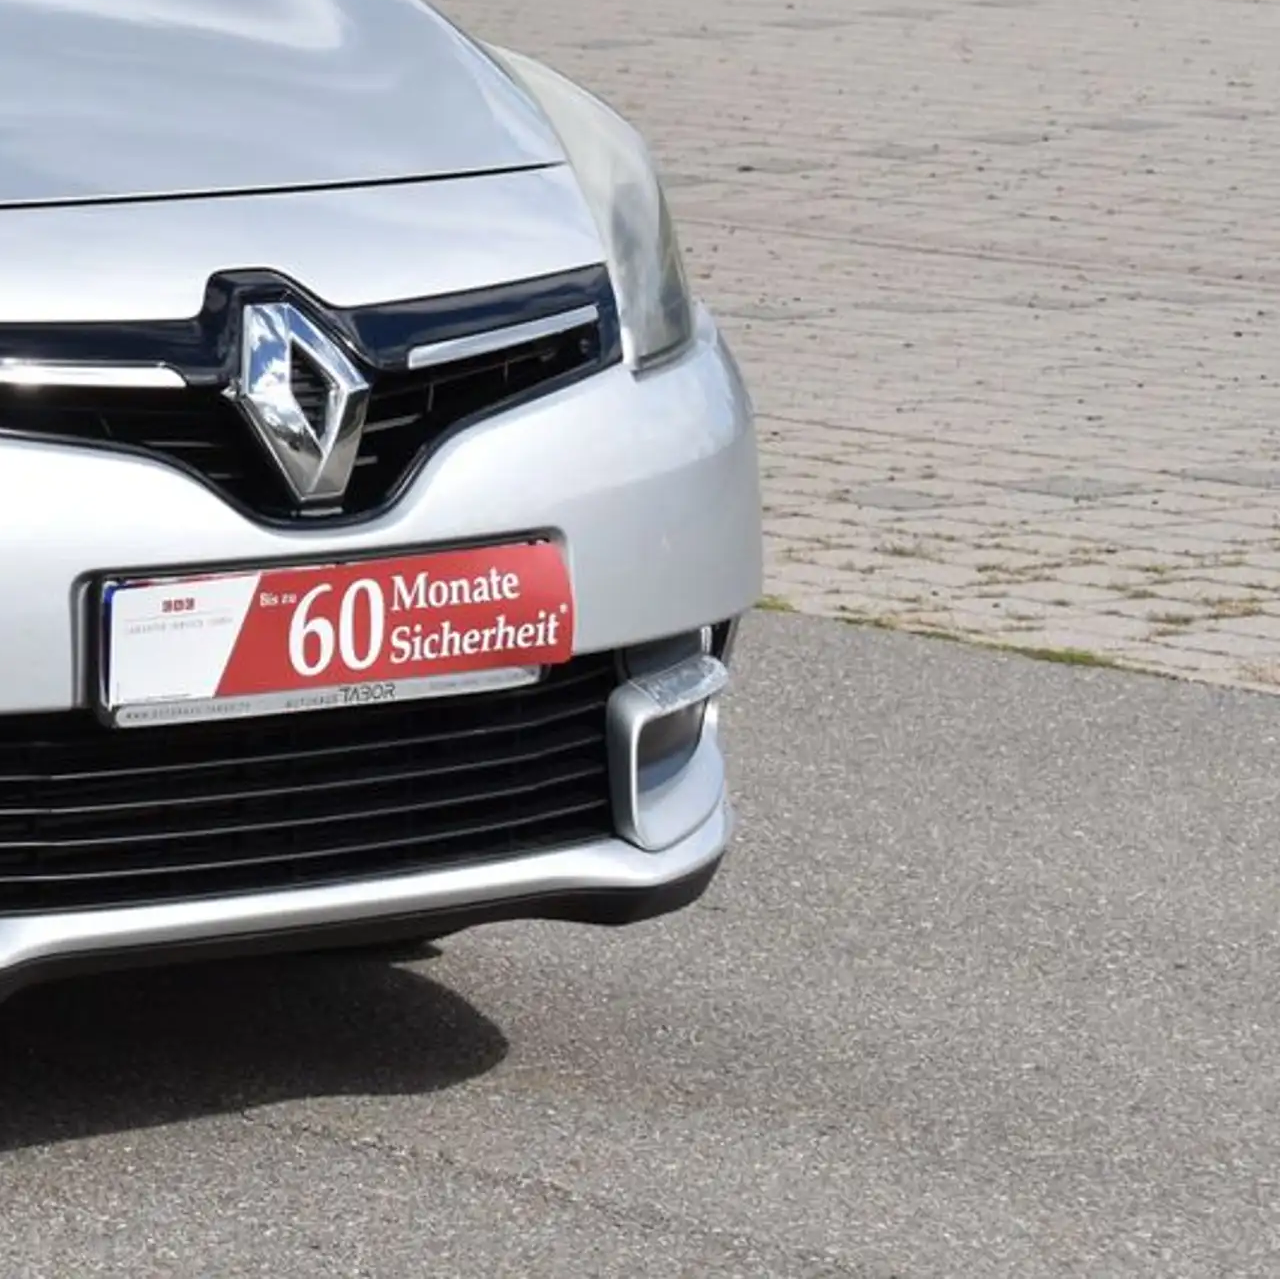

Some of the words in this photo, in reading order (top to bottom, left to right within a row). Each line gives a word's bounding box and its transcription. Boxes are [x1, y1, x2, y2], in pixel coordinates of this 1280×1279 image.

[391, 566, 521, 611] Monate
[260, 592, 279, 608] Bis
[288, 578, 385, 677] 60
[339, 682, 396, 704] TABOR
